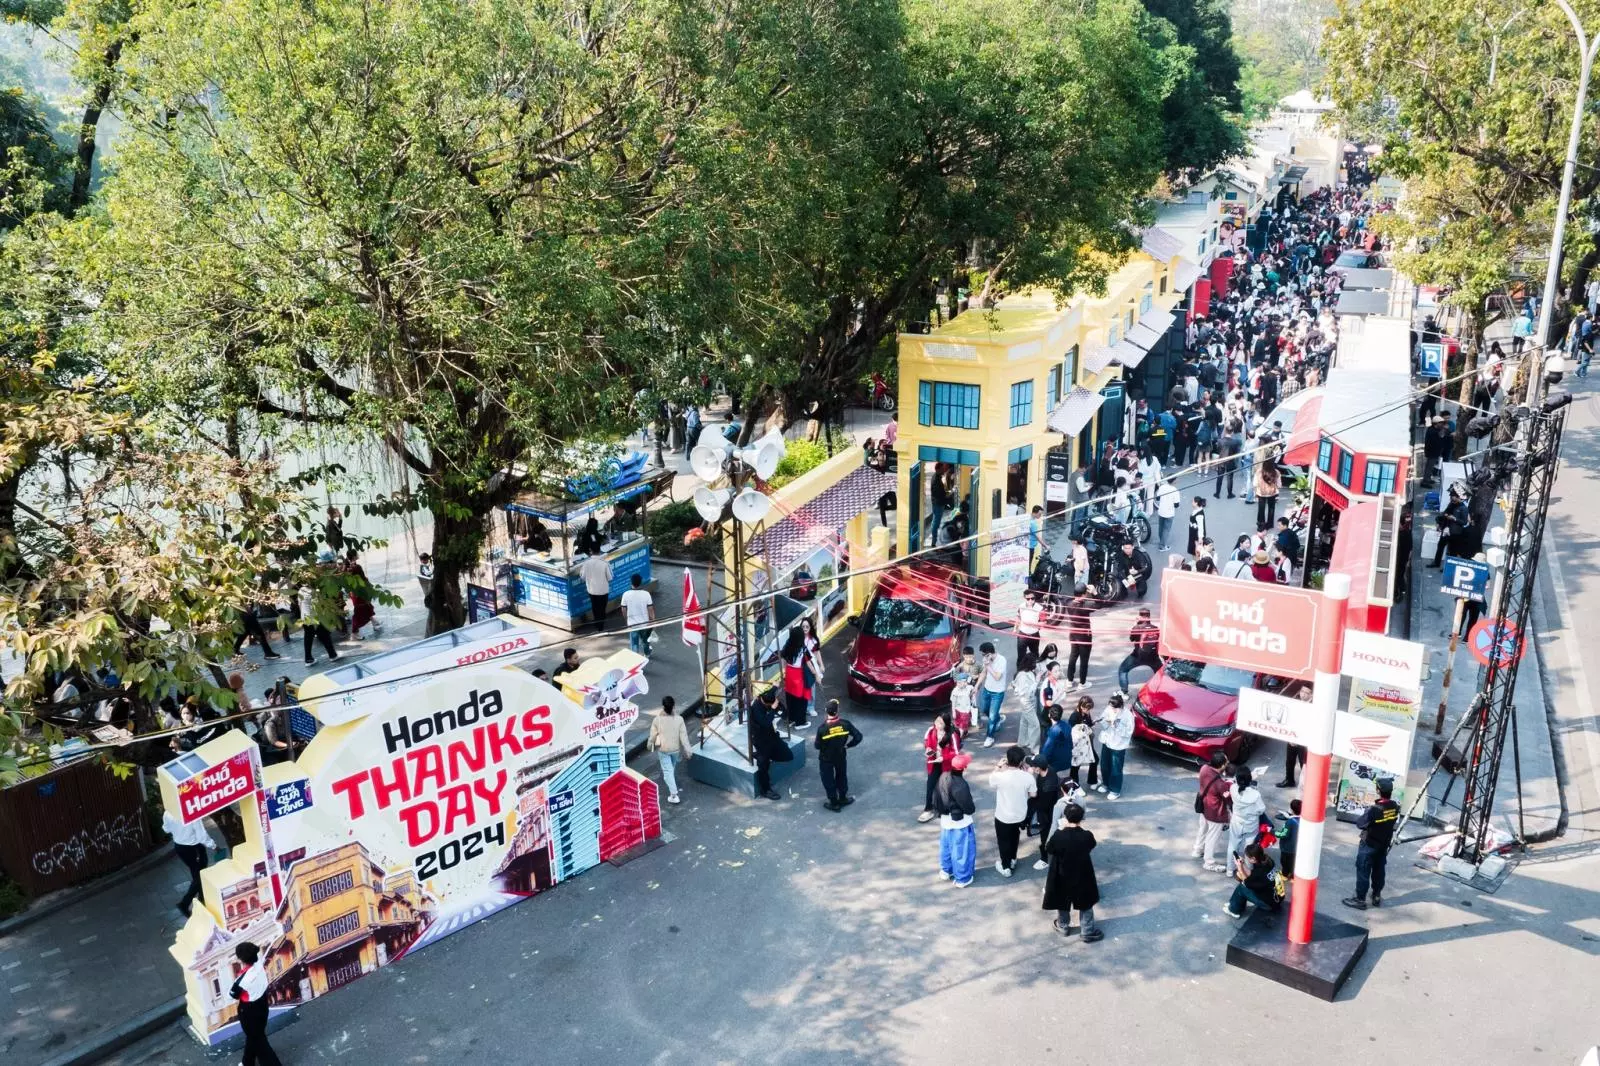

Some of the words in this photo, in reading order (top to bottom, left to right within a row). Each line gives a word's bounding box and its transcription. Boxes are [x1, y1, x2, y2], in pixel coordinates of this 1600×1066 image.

[1425, 350, 1438, 369] P
[1453, 565, 1475, 588] P
[1216, 598, 1266, 625] PHỐ
[1190, 615, 1287, 655] Honda
[456, 637, 529, 667] HONDA
[1352, 651, 1411, 671] HONDA
[382, 689, 503, 754] Honda
[583, 715, 617, 734] THANKS
[618, 707, 636, 721] DAY
[1247, 720, 1298, 738] HONDA
[331, 705, 554, 821] THANKS
[1349, 748, 1389, 765] HONDA
[200, 762, 231, 791] PHỐ
[185, 775, 248, 816] Honda
[399, 768, 508, 848] DAY
[415, 822, 505, 882] 2024
